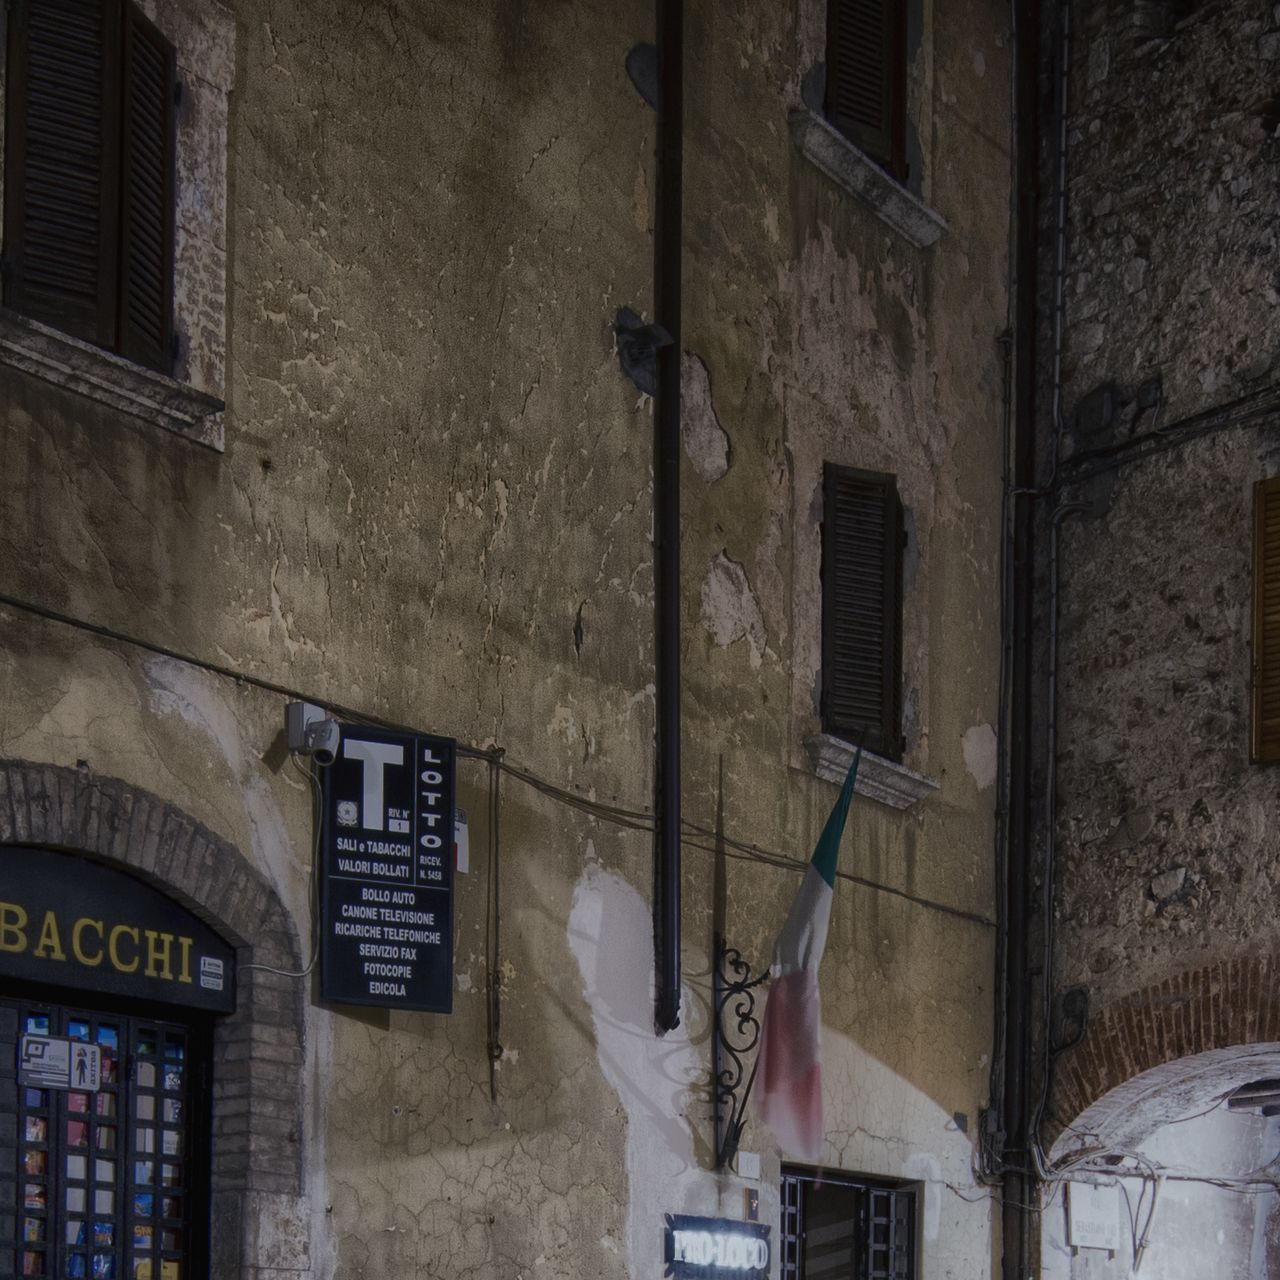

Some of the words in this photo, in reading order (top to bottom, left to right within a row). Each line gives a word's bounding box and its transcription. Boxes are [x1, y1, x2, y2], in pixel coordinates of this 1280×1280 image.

[343, 738, 404, 831] T
[421, 749, 442, 849] LOTTO
[337, 838, 357, 851] SALI
[359, 843, 364, 852] e
[367, 841, 411, 857] TABACCHI
[338, 859, 371, 873] VALORI
[372, 862, 409, 878] BOLLATI
[420, 855, 442, 866] RICEV.
[362, 888, 390, 902] BOLLO
[392, 892, 415, 905] AUTO
[342, 905, 377, 920] CANONE
[379, 909, 434, 925] TELEVISIONE
[335, 923, 382, 939] RICARICHE
[383, 928, 440, 944] TELEFONICHE
[359, 943, 398, 959] SERVIZIO
[400, 947, 417, 960] FAX
[364, 962, 412, 978] FOTOCOPIE
[369, 981, 406, 996] EDICOLA
